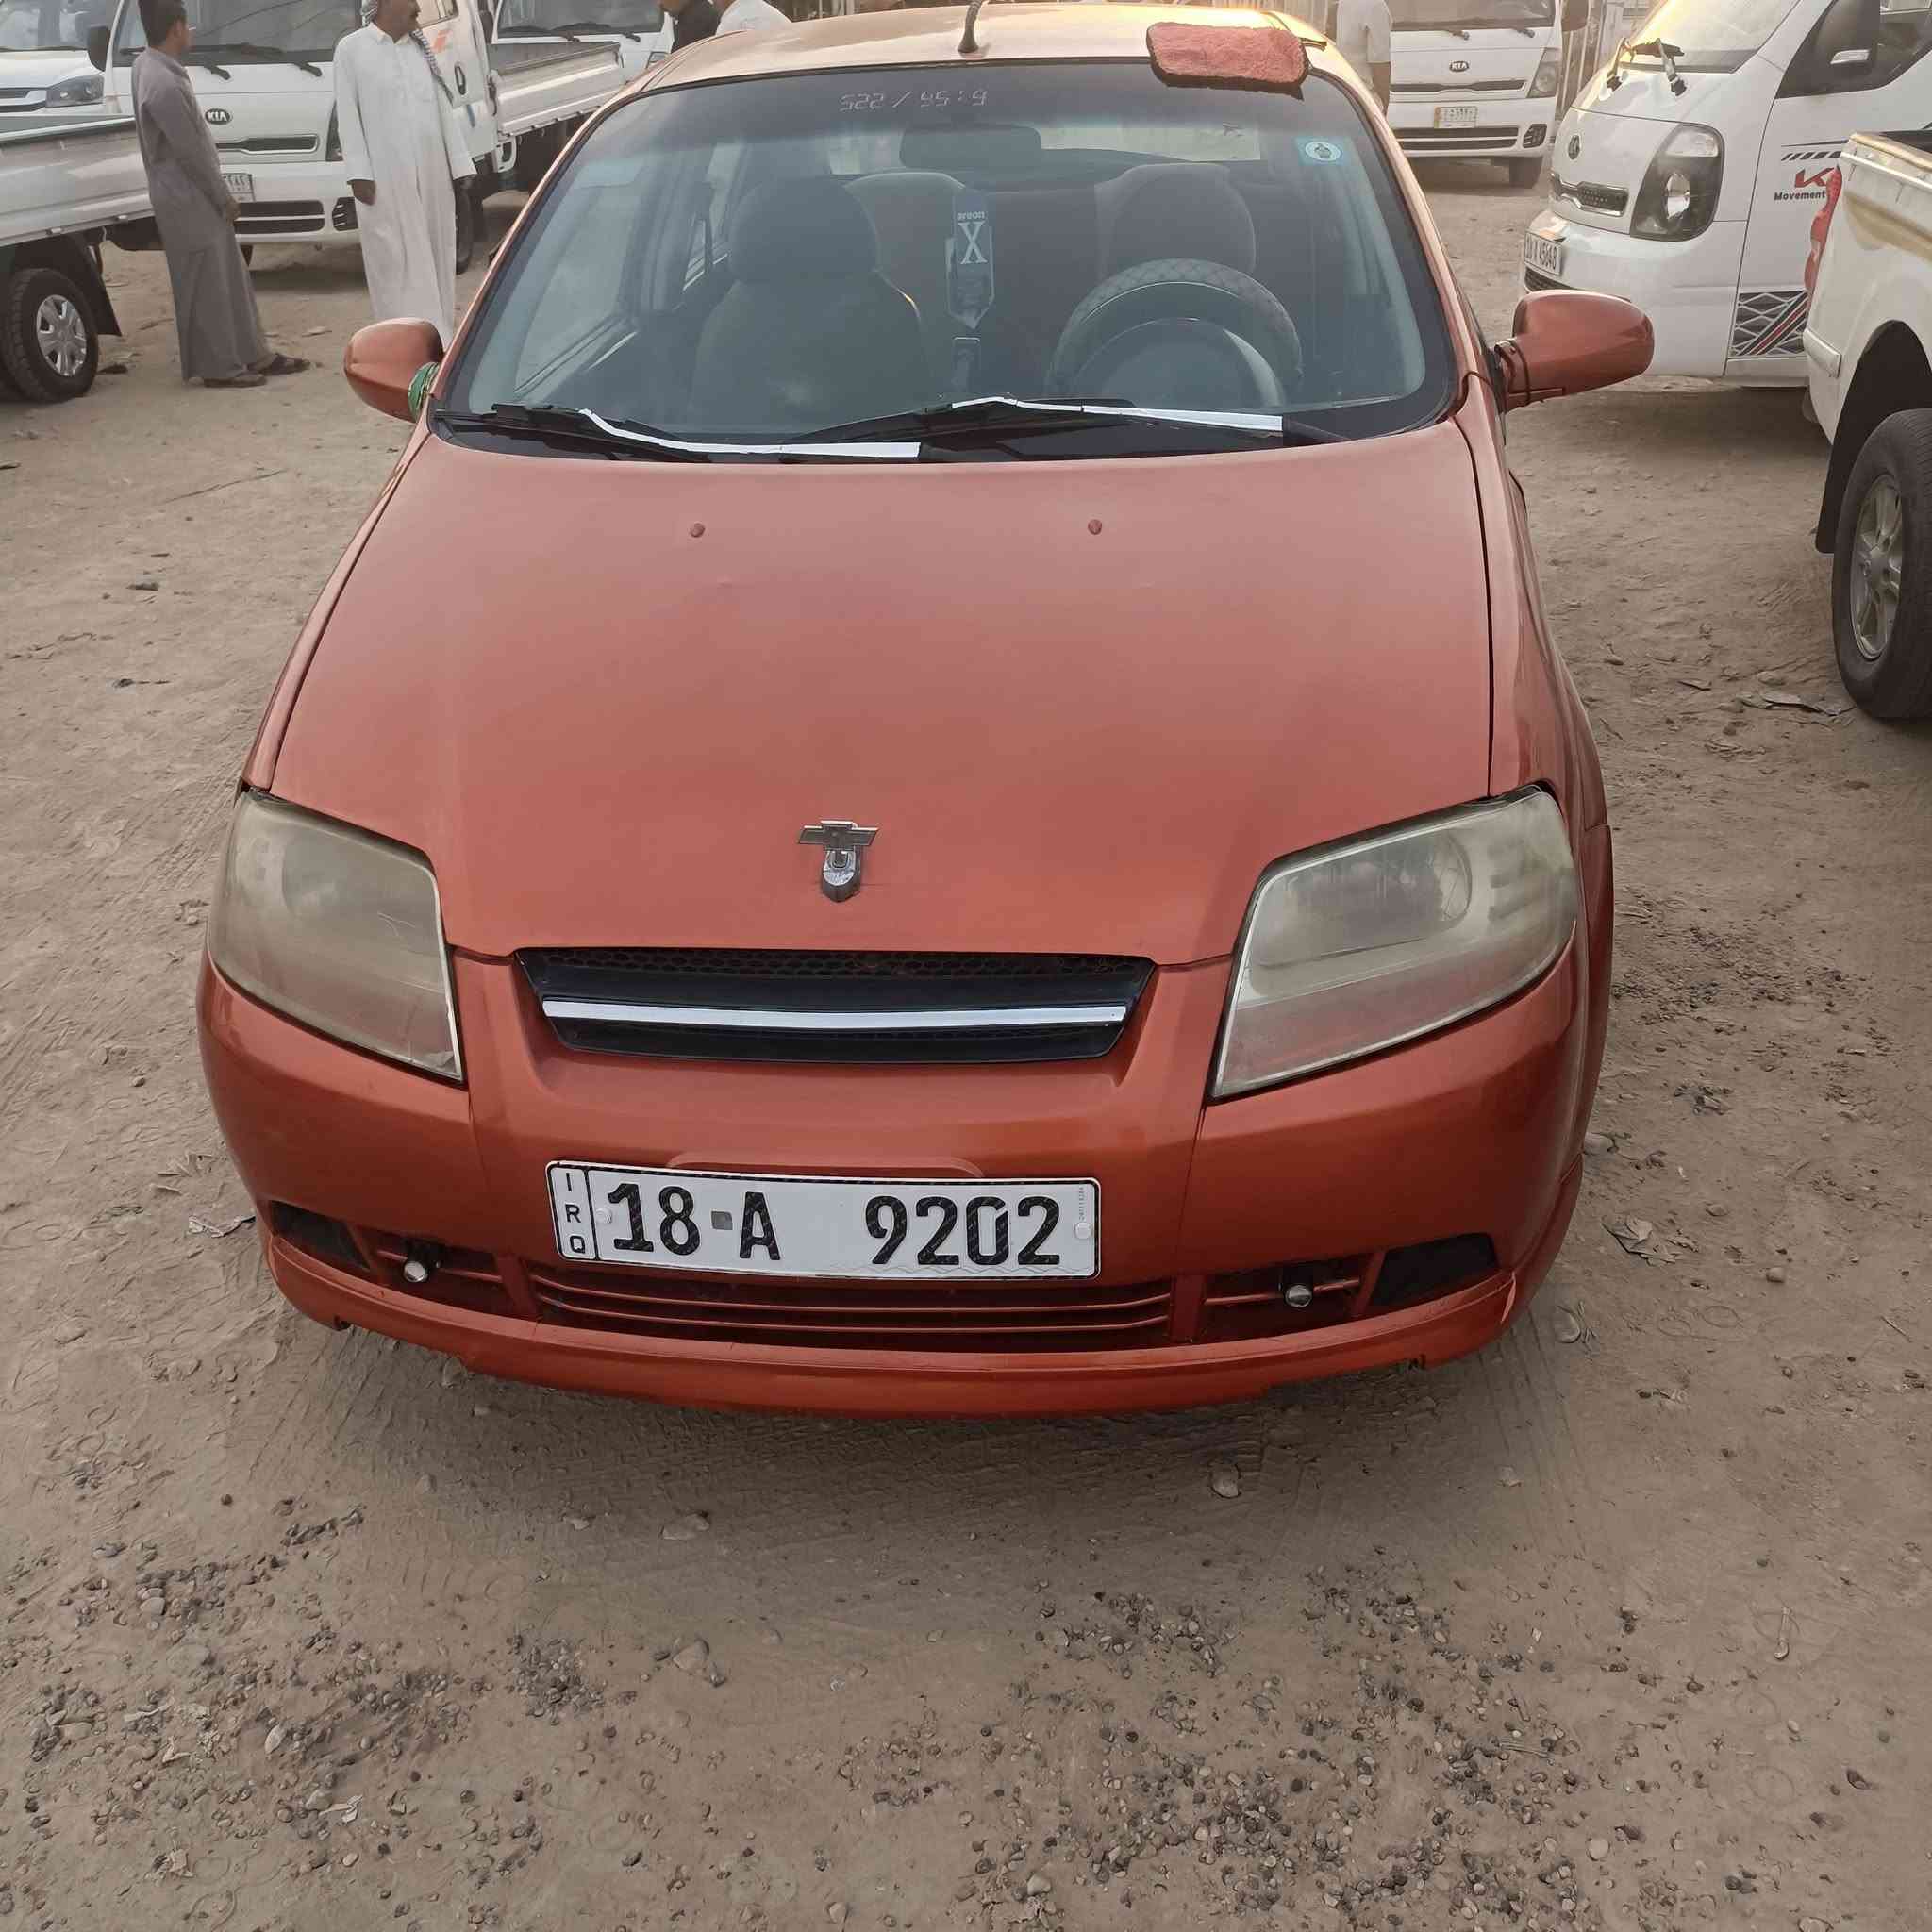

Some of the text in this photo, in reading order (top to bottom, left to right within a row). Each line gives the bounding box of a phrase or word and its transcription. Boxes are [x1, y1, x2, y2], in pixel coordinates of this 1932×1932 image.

[207, 110, 228, 122] KIA
[1774, 190, 1826, 201] Movement
[958, 221, 988, 265] X
[608, 1182, 702, 1256] 18
[739, 1191, 781, 1261] A
[864, 1195, 1061, 1266] 9202
